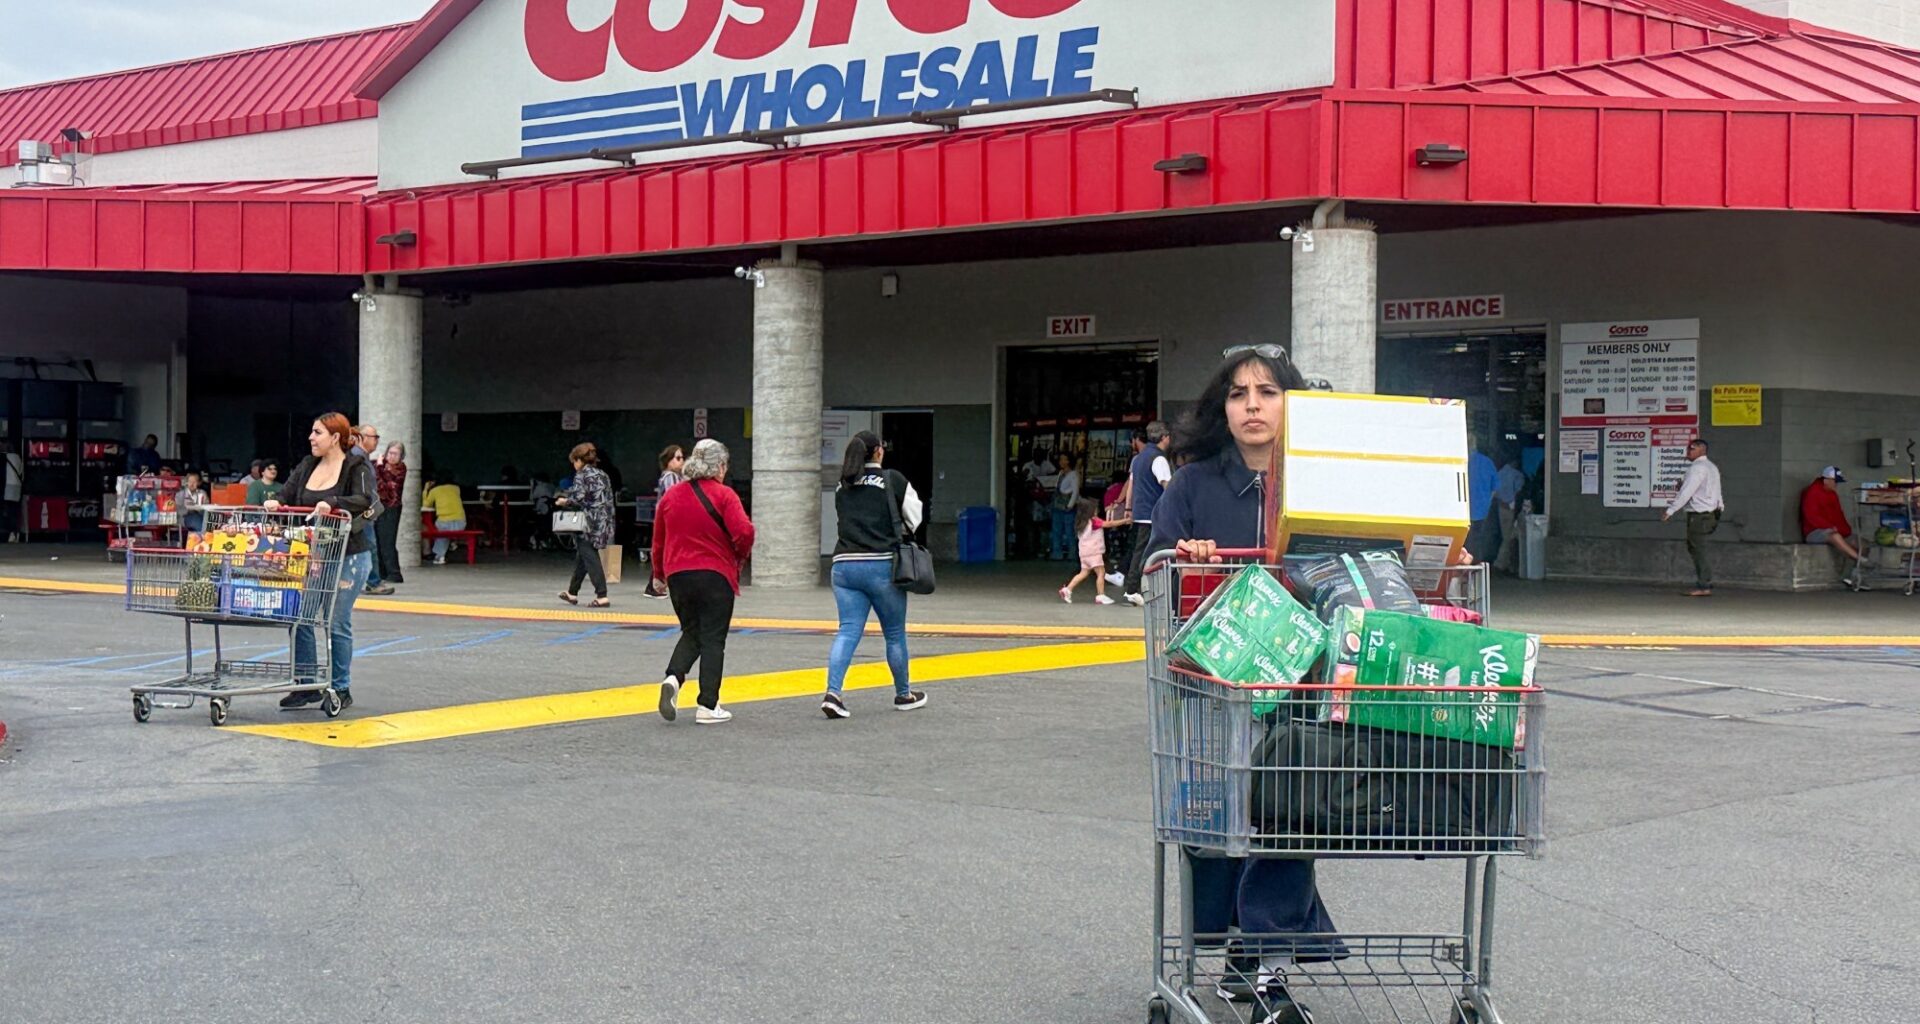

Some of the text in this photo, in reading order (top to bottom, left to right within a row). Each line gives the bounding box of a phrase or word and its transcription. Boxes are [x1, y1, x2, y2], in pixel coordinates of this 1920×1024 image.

[524, 0, 1083, 82] COS
[680, 26, 1099, 140] WHOLESALE
[1384, 297, 1501, 320] ENTRANCE
[1052, 318, 1090, 334] EXIT
[1608, 325, 1649, 335] COSTCO
[1587, 342, 1670, 355] MEMBERS ONLY
[1608, 430, 1646, 439] COSTCO
[1248, 574, 1283, 607] Kleenex
[1213, 615, 1247, 649] Kleenex
[1289, 611, 1324, 644] Kleenex
[1369, 629, 1385, 647] 12
[1253, 653, 1289, 685] Kleenex
[1468, 671, 1480, 699] Lotn
